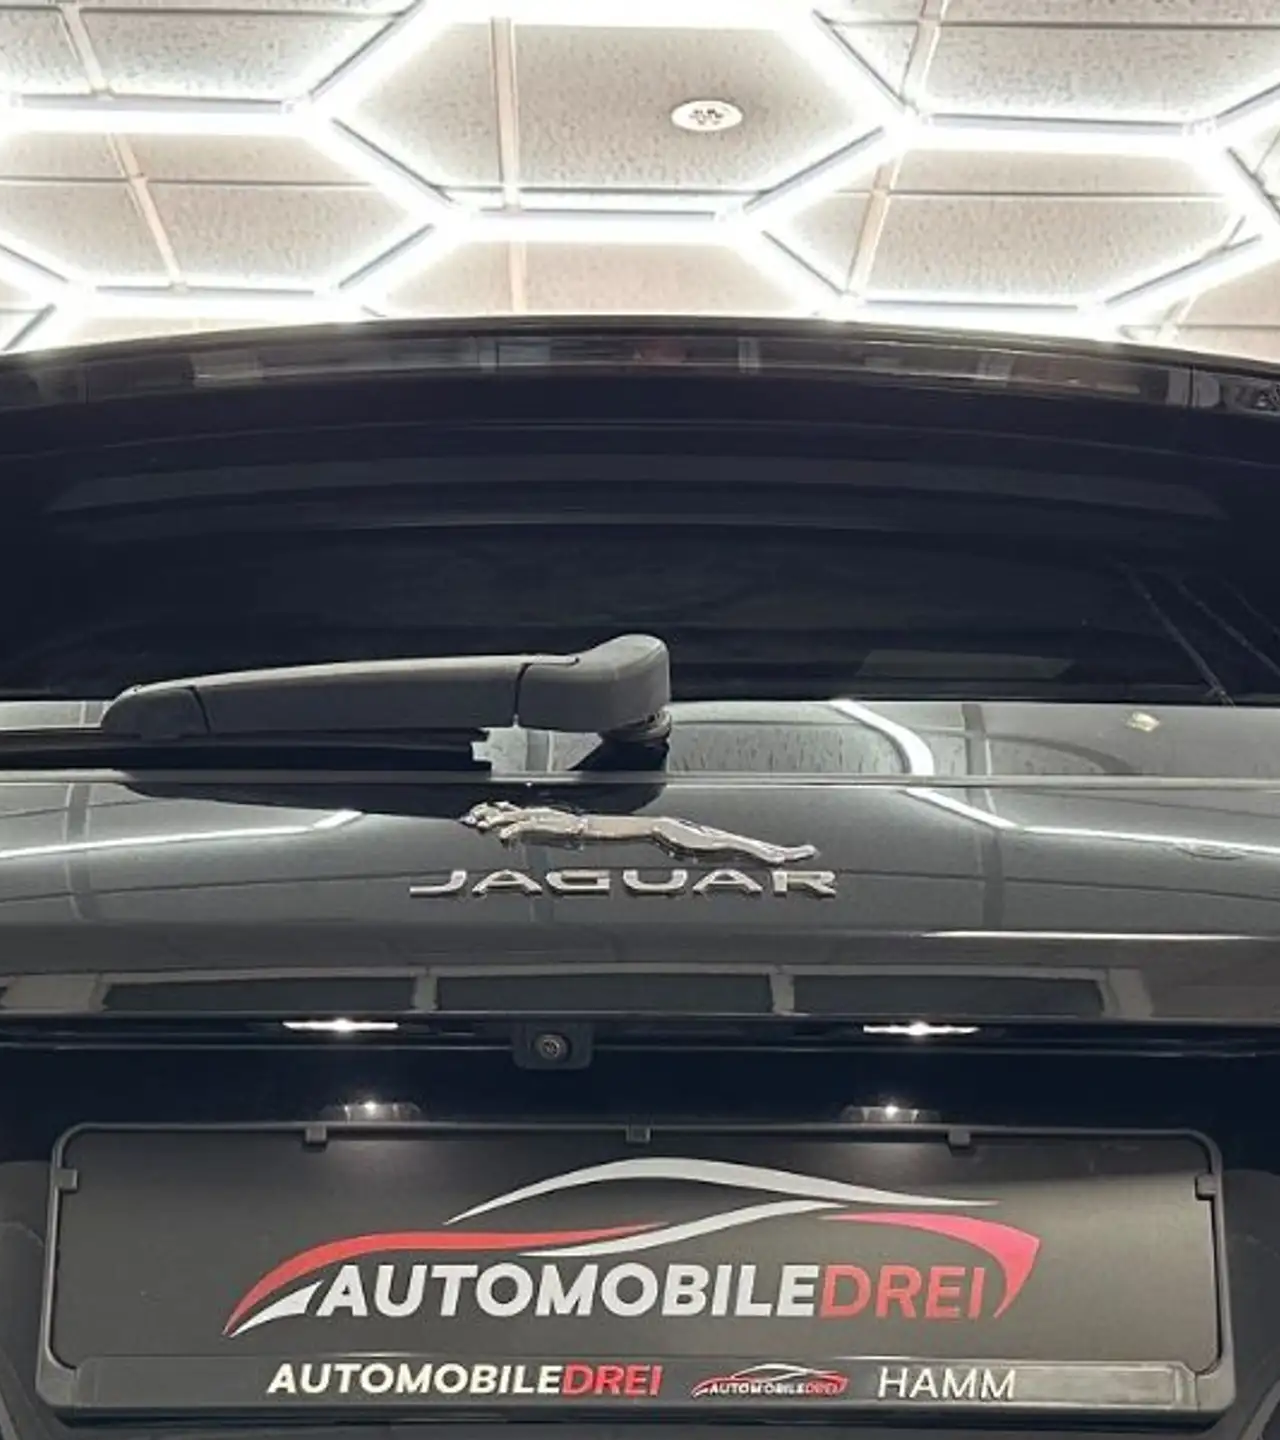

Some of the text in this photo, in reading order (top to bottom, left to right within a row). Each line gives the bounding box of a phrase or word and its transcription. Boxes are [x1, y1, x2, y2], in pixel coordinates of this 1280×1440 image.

[409, 869, 838, 897] JAGUAR
[318, 1261, 987, 1320] AUTOMOBILEDREI
[266, 1362, 663, 1397] AUTOMOBILEDREI
[876, 1366, 1017, 1400] HAMM
